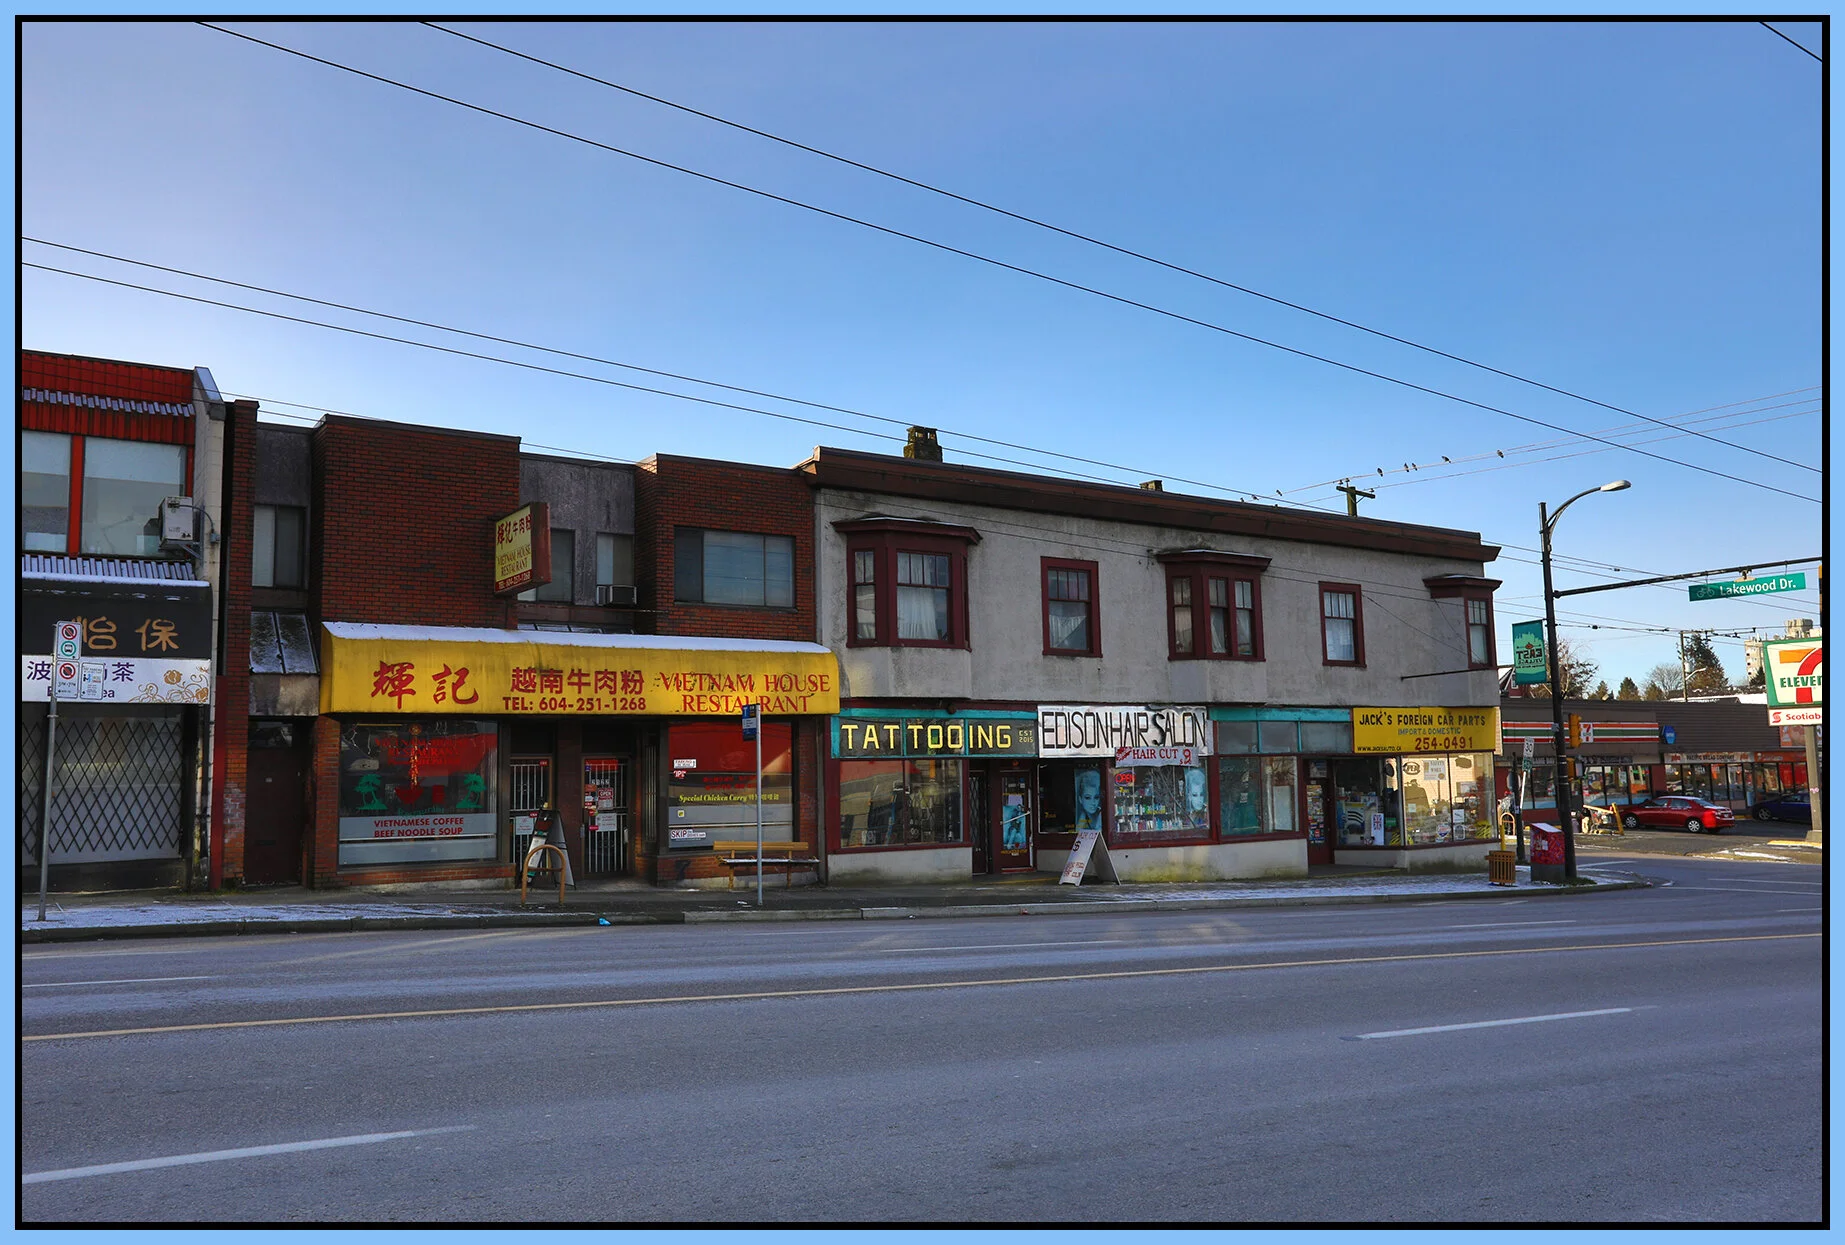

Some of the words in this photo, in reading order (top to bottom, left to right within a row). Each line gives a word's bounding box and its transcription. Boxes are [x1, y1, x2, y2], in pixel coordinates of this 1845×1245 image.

[1720, 578, 1776, 596] Lakewood
[1780, 578, 1797, 589] Dr.
[510, 667, 645, 695] 越南牛肉粉
[660, 672, 754, 693] VIETNAM
[764, 674, 830, 692] HOUSE
[502, 697, 533, 711] TEL:
[538, 697, 647, 711] 604-251-1268
[1359, 711, 1393, 726] JACK'S
[1397, 714, 1433, 726] FOREIGN
[1437, 714, 1454, 726] CAR
[1458, 714, 1486, 726] PARTS
[1786, 712, 1822, 721] Scotiab
[1152, 711, 1208, 749] SALON
[1398, 728, 1422, 736] IMPORT
[1428, 727, 1461, 735] DOMESTIC
[841, 724, 1012, 749] TATTOOING
[1132, 748, 1156, 759] HAIR
[1159, 747, 1179, 759] CUT
[1115, 773, 1135, 783] OPEN
[679, 794, 703, 803] Special
[703, 794, 729, 802] Chicken
[729, 794, 748, 803] Curry
[374, 818, 430, 828] VIETNAMESE
[432, 817, 464, 825] COFFEE
[374, 829, 394, 838] BEEF
[397, 828, 436, 837] NOODLE
[438, 827, 463, 836] SOUP
[671, 830, 687, 839] SKIP
